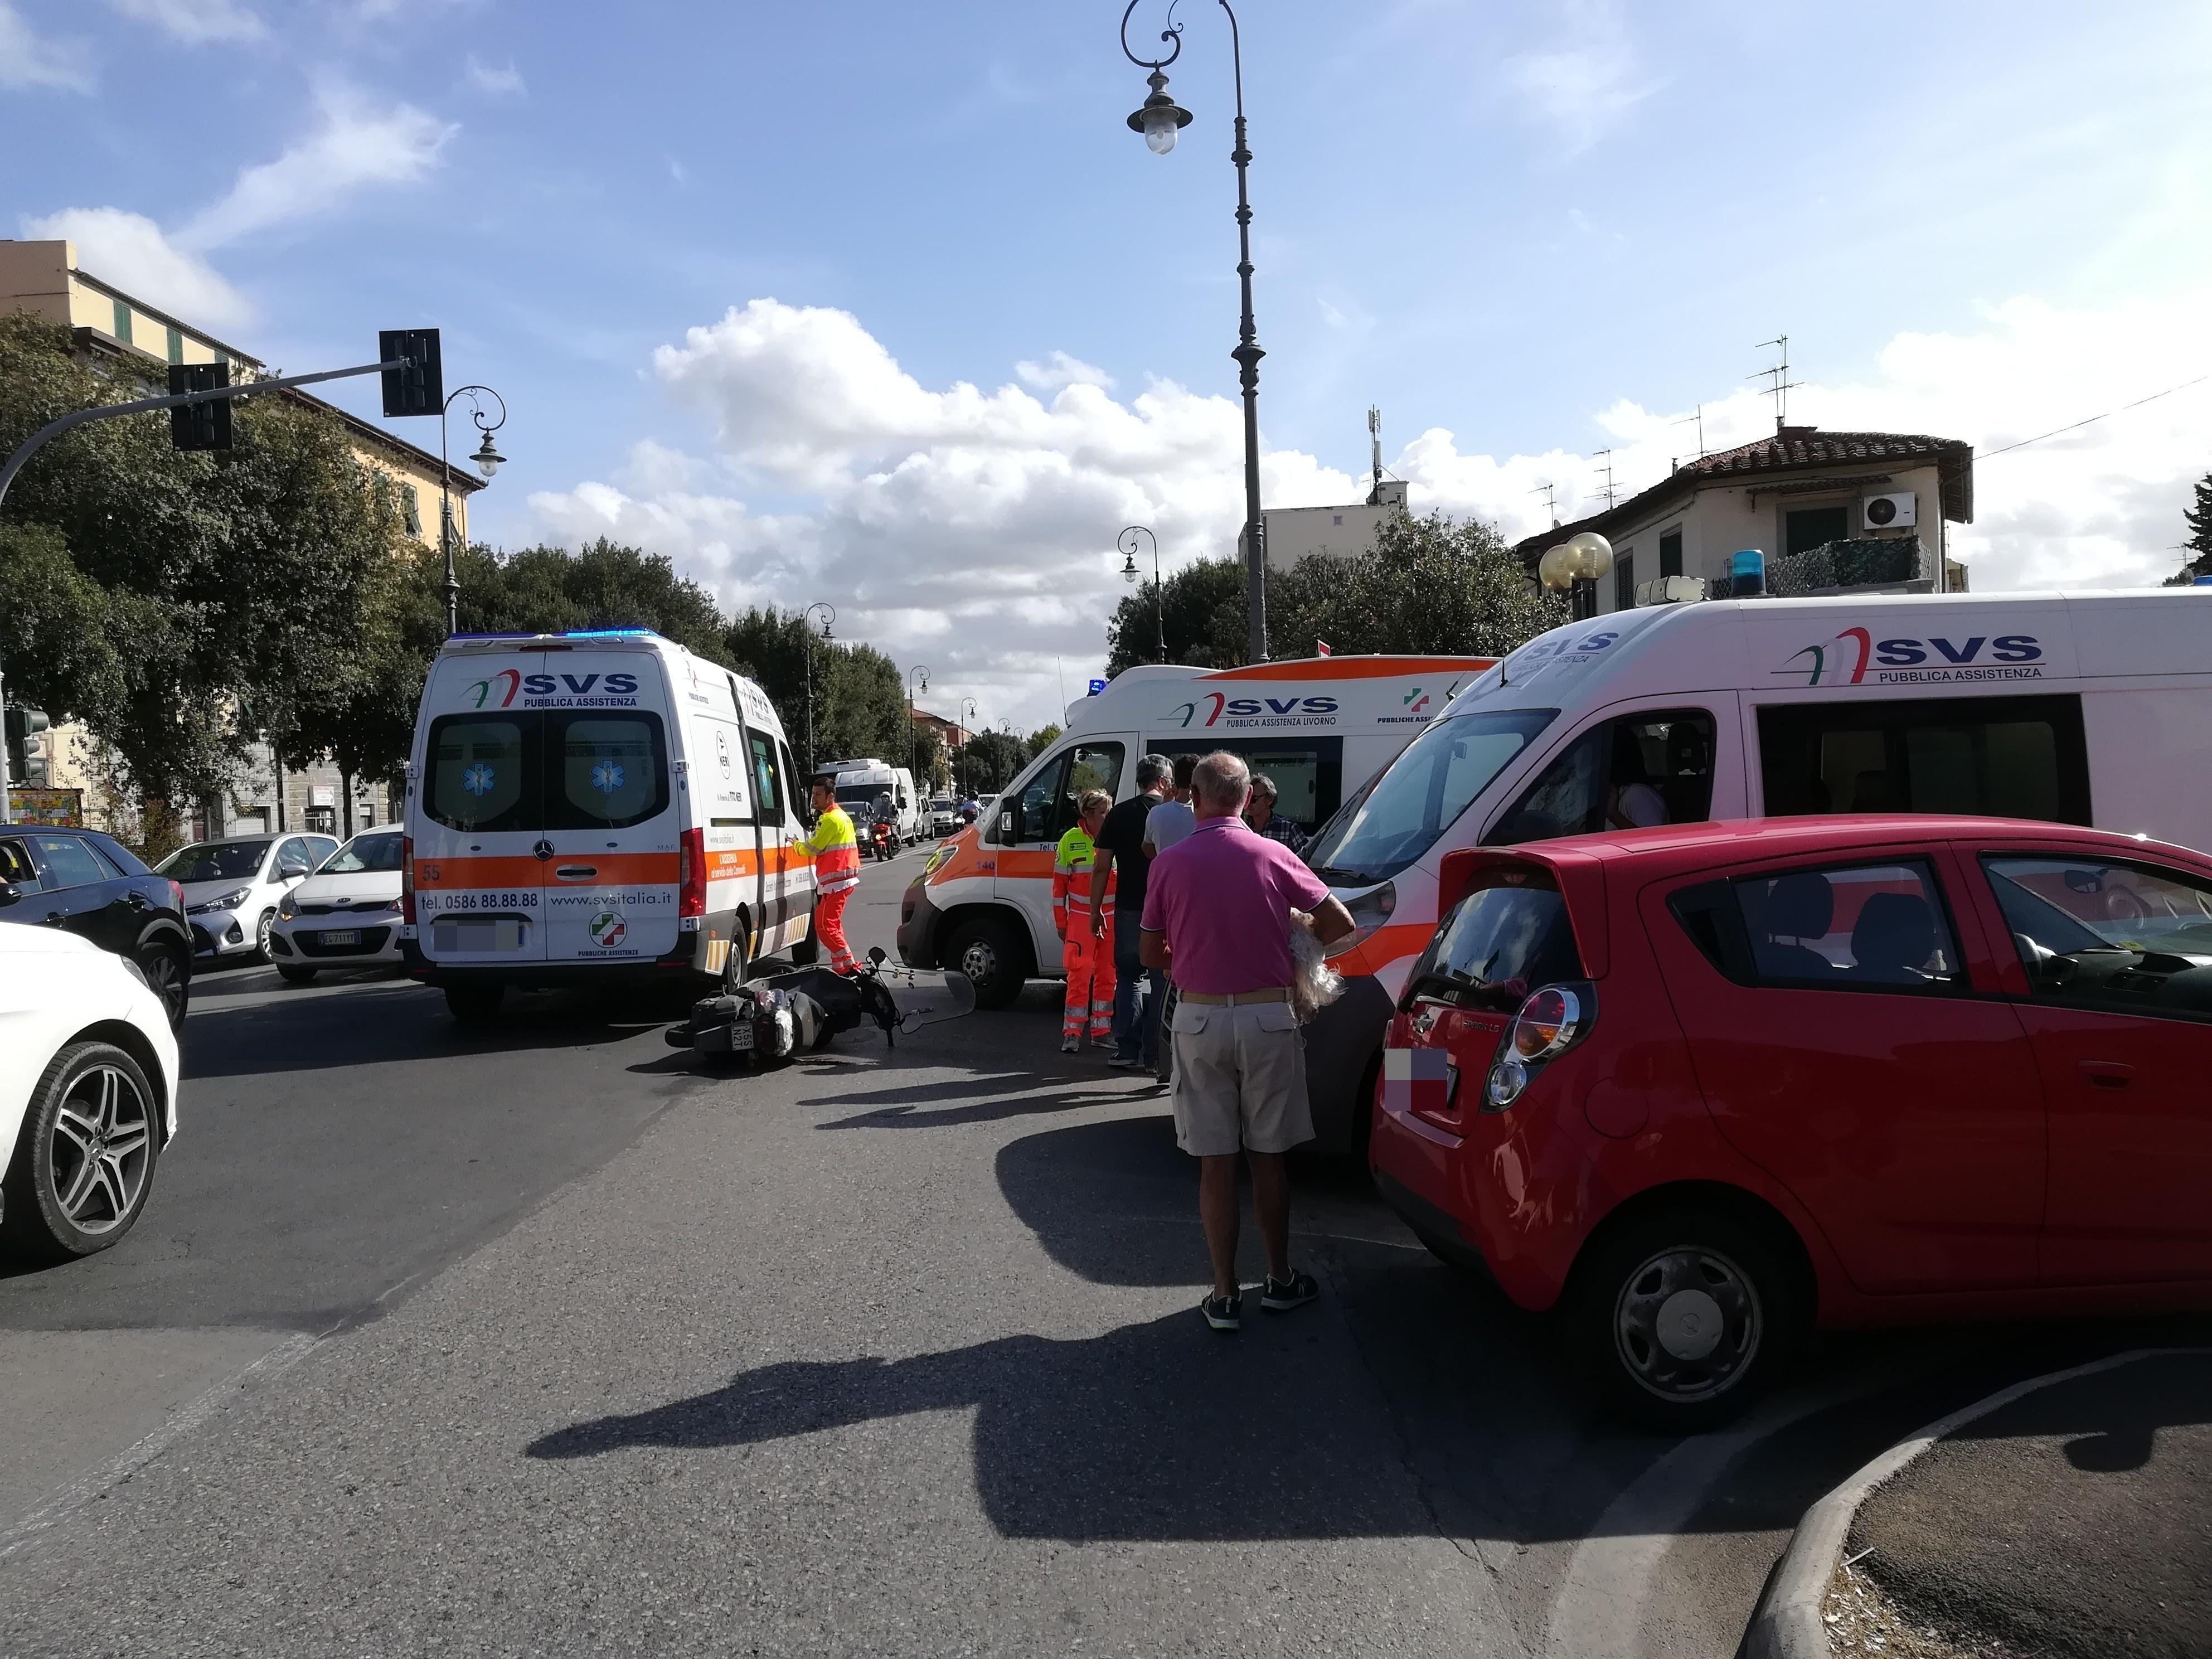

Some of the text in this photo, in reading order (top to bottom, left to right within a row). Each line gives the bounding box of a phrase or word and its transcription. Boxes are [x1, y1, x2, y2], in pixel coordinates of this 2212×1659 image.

[1876, 636, 2042, 665] SVS
[1880, 668, 2042, 682] PUBBLICA ASSISTENZA
[523, 673, 638, 695] SVS
[524, 697, 637, 707] PUBBLICA ASSISTENZA
[750, 688, 769, 714] SVS
[1226, 697, 1338, 716] SVS
[1226, 717, 1336, 727] PUBBLICA ASSISTENZA LIVORNO
[719, 755, 730, 767] NERI
[423, 865, 440, 881] 55
[976, 861, 995, 870] 140
[421, 893, 538, 910] tel. 0586 88.88.88
[550, 892, 672, 905] www.svsitalia.it
